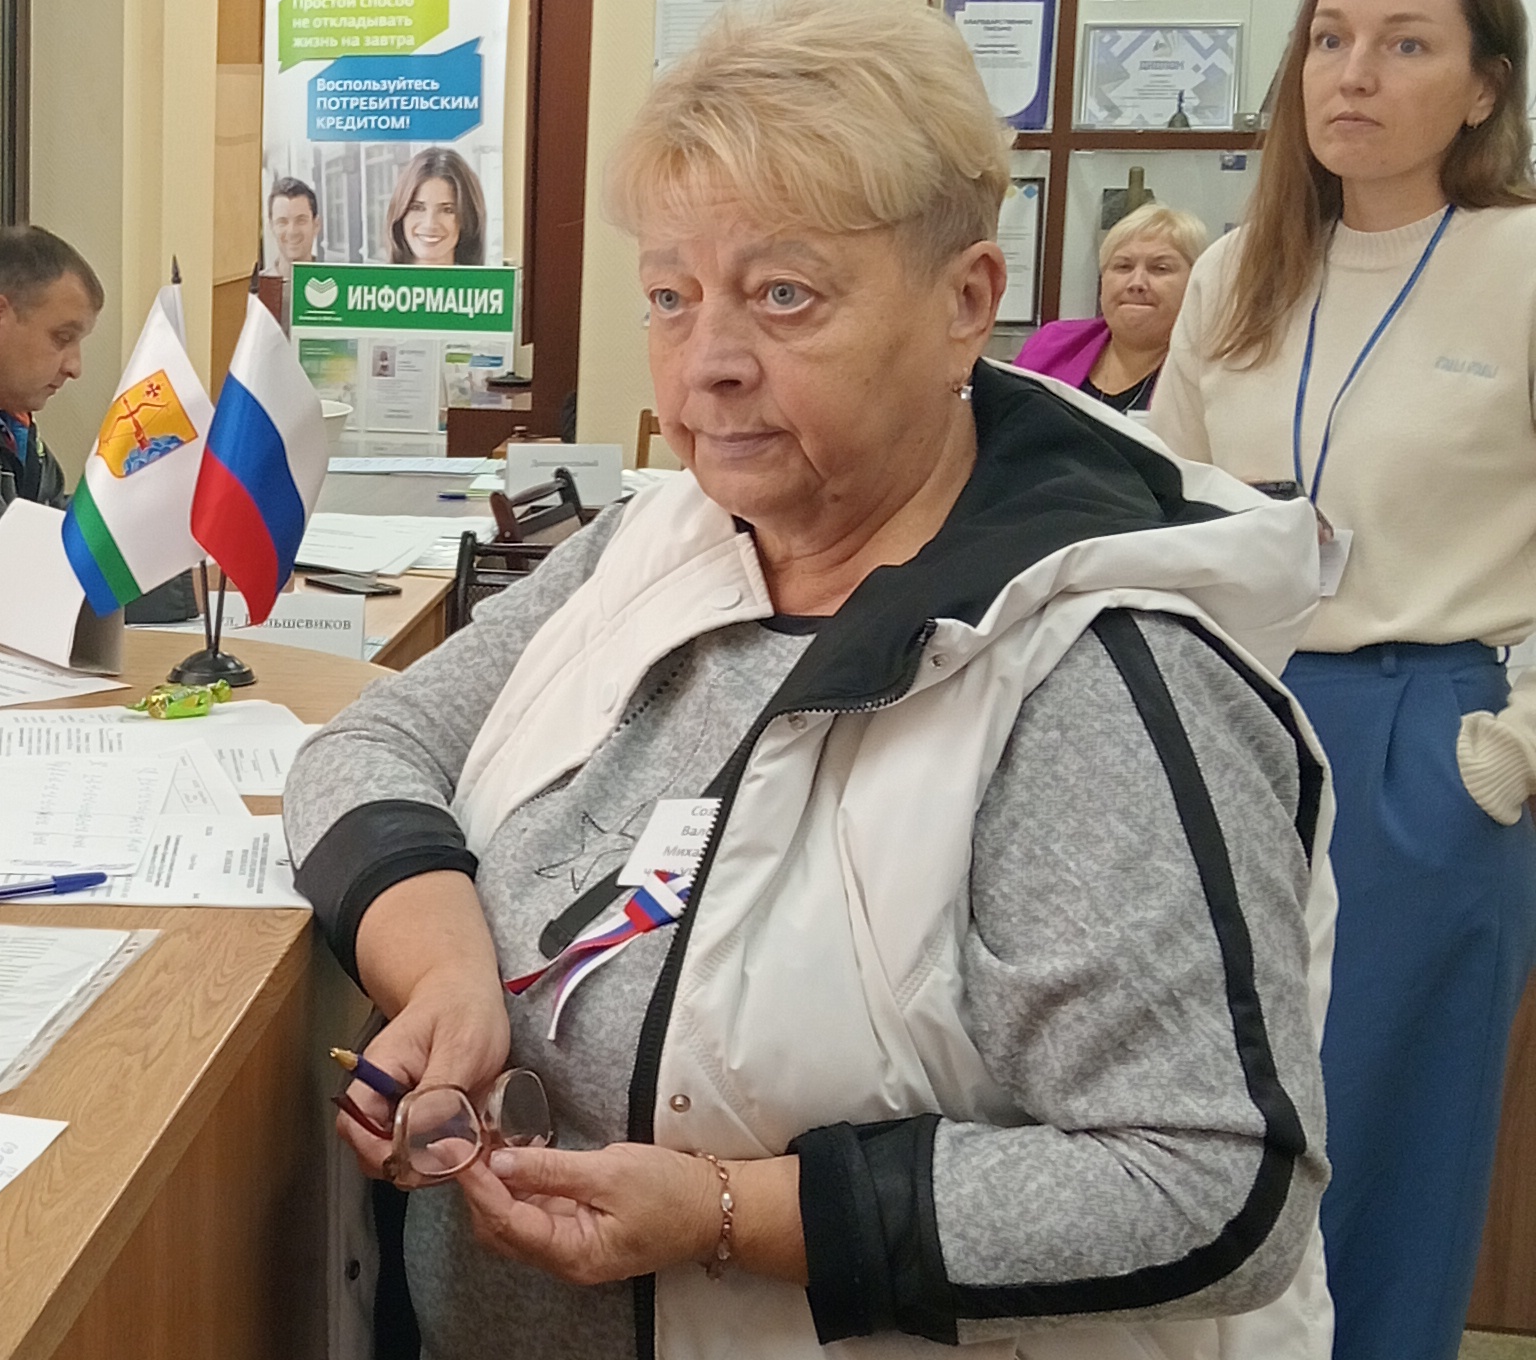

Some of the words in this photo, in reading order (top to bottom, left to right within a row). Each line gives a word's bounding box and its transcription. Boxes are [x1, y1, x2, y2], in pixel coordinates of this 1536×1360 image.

[293, 17, 309, 28] не
[313, 15, 413, 30] откладывать
[293, 36, 338, 48] жизнь
[341, 36, 360, 47] на
[364, 34, 414, 49] завтра
[316, 76, 440, 94] Воспользуйтесь
[316, 96, 480, 110] ПОТРЕБИТЕЛЬСКИМ
[316, 115, 411, 131] КРЕДИТОМ!
[347, 285, 504, 318] ИНФОРМАЦИЯ
[245, 614, 351, 630] льшевиков
